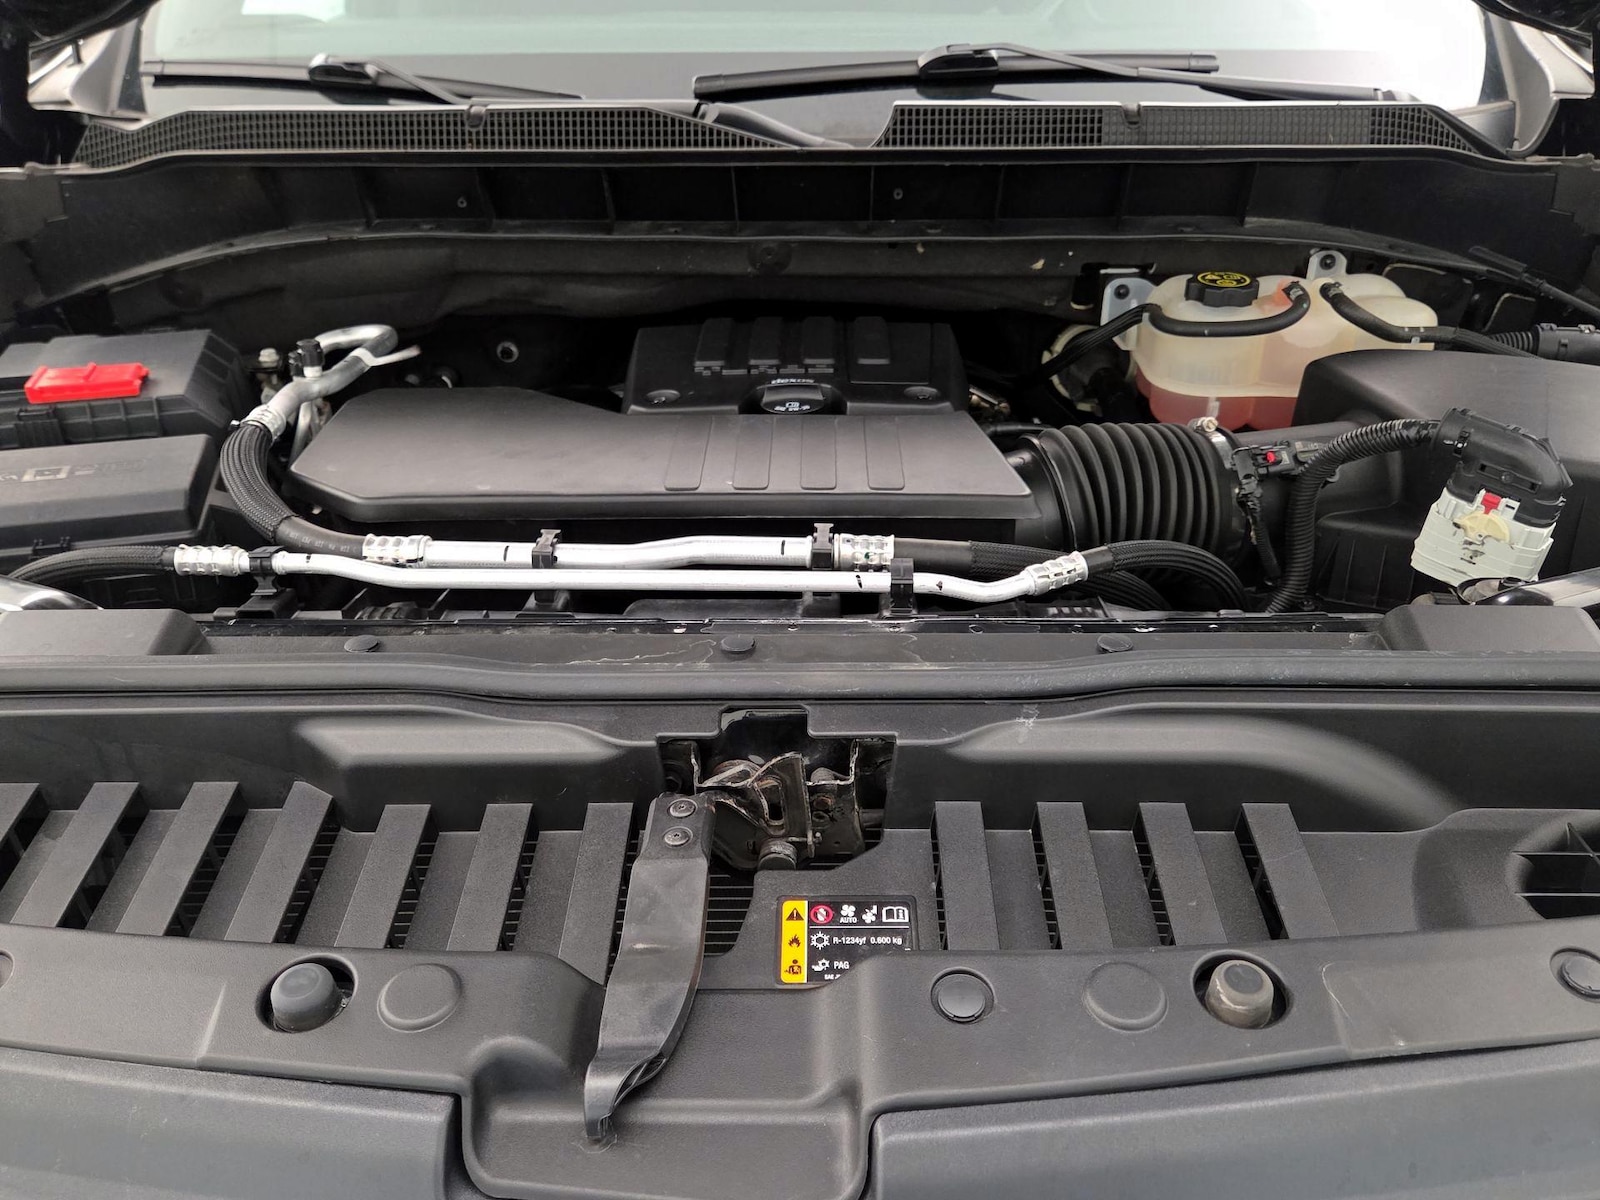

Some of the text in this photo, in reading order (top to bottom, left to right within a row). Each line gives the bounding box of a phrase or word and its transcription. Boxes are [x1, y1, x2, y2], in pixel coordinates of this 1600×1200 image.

[833, 937, 866, 945] R-1234yf
[892, 937, 902, 945] kg
[833, 961, 850, 969] PAG
